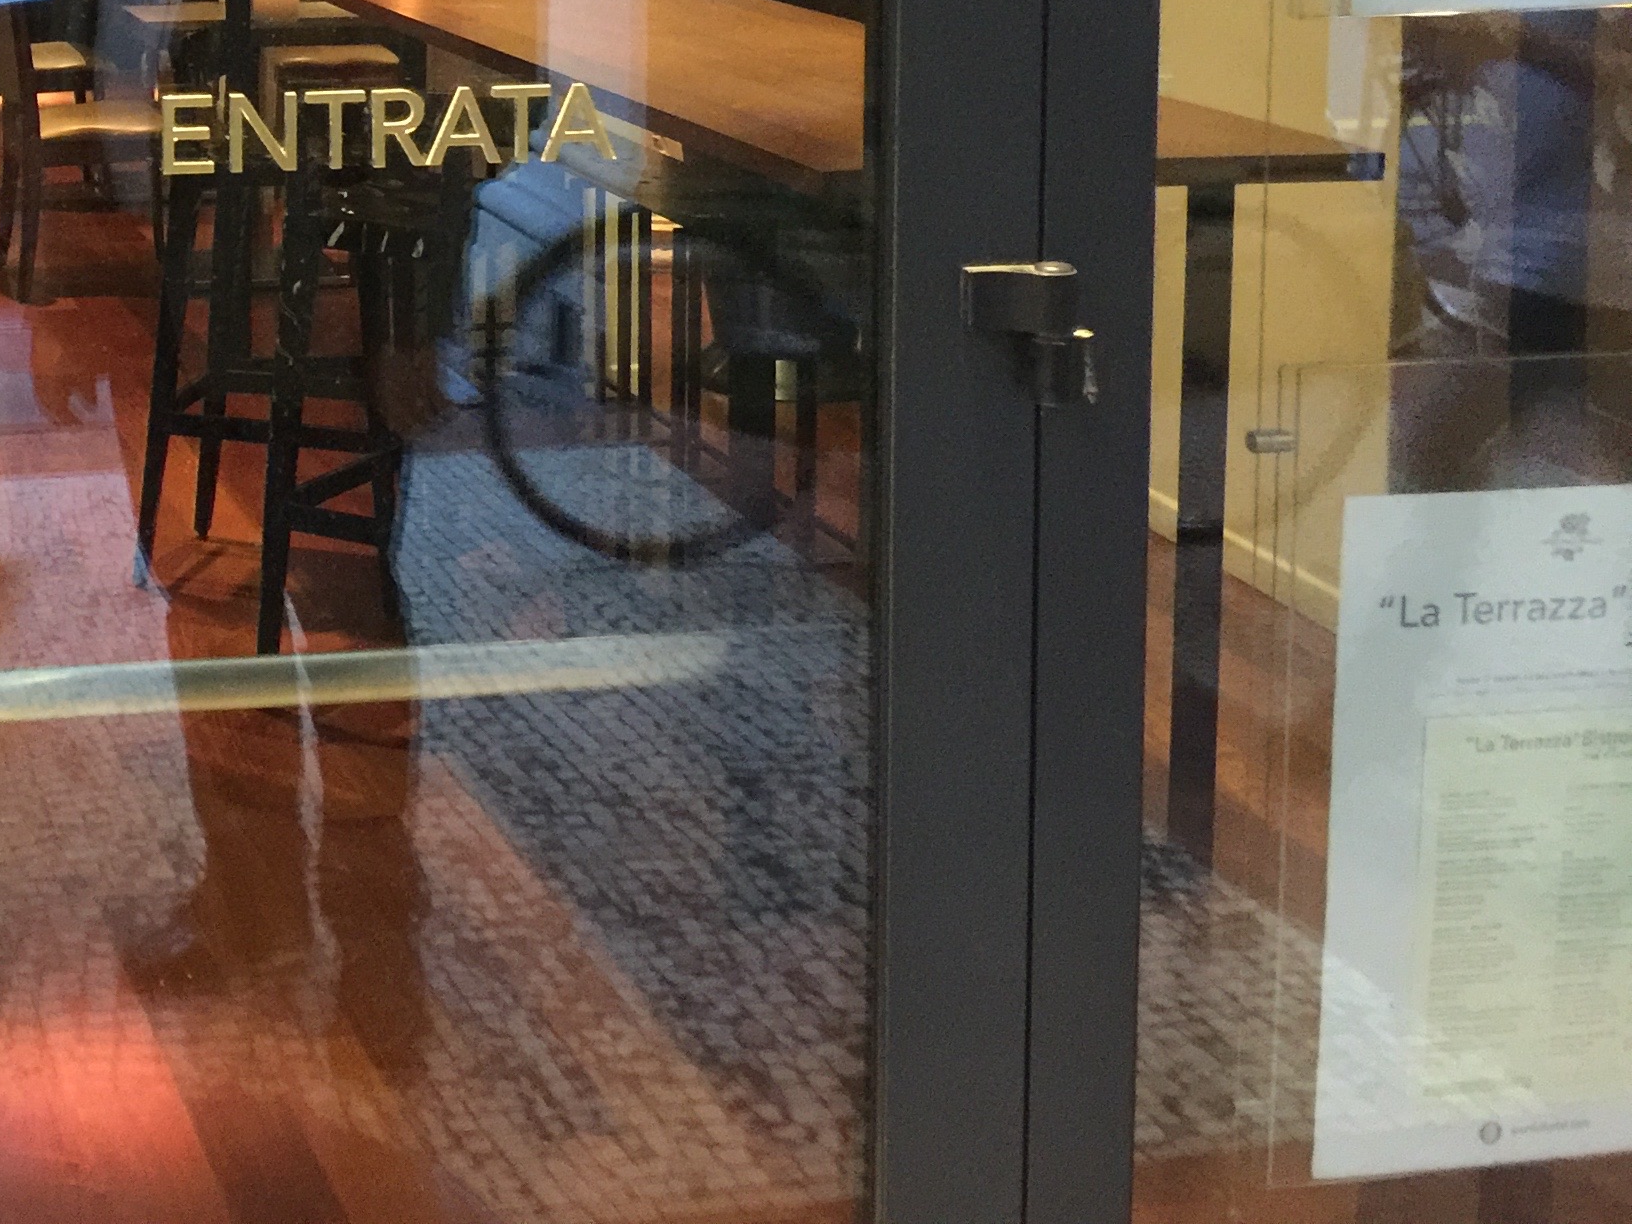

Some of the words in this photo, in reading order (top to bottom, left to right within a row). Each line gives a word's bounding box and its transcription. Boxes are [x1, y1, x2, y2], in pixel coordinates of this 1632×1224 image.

[161, 82, 617, 175] ENTRATA
[1380, 596, 1441, 629] "La
[1453, 584, 1627, 625] Terrazza"
